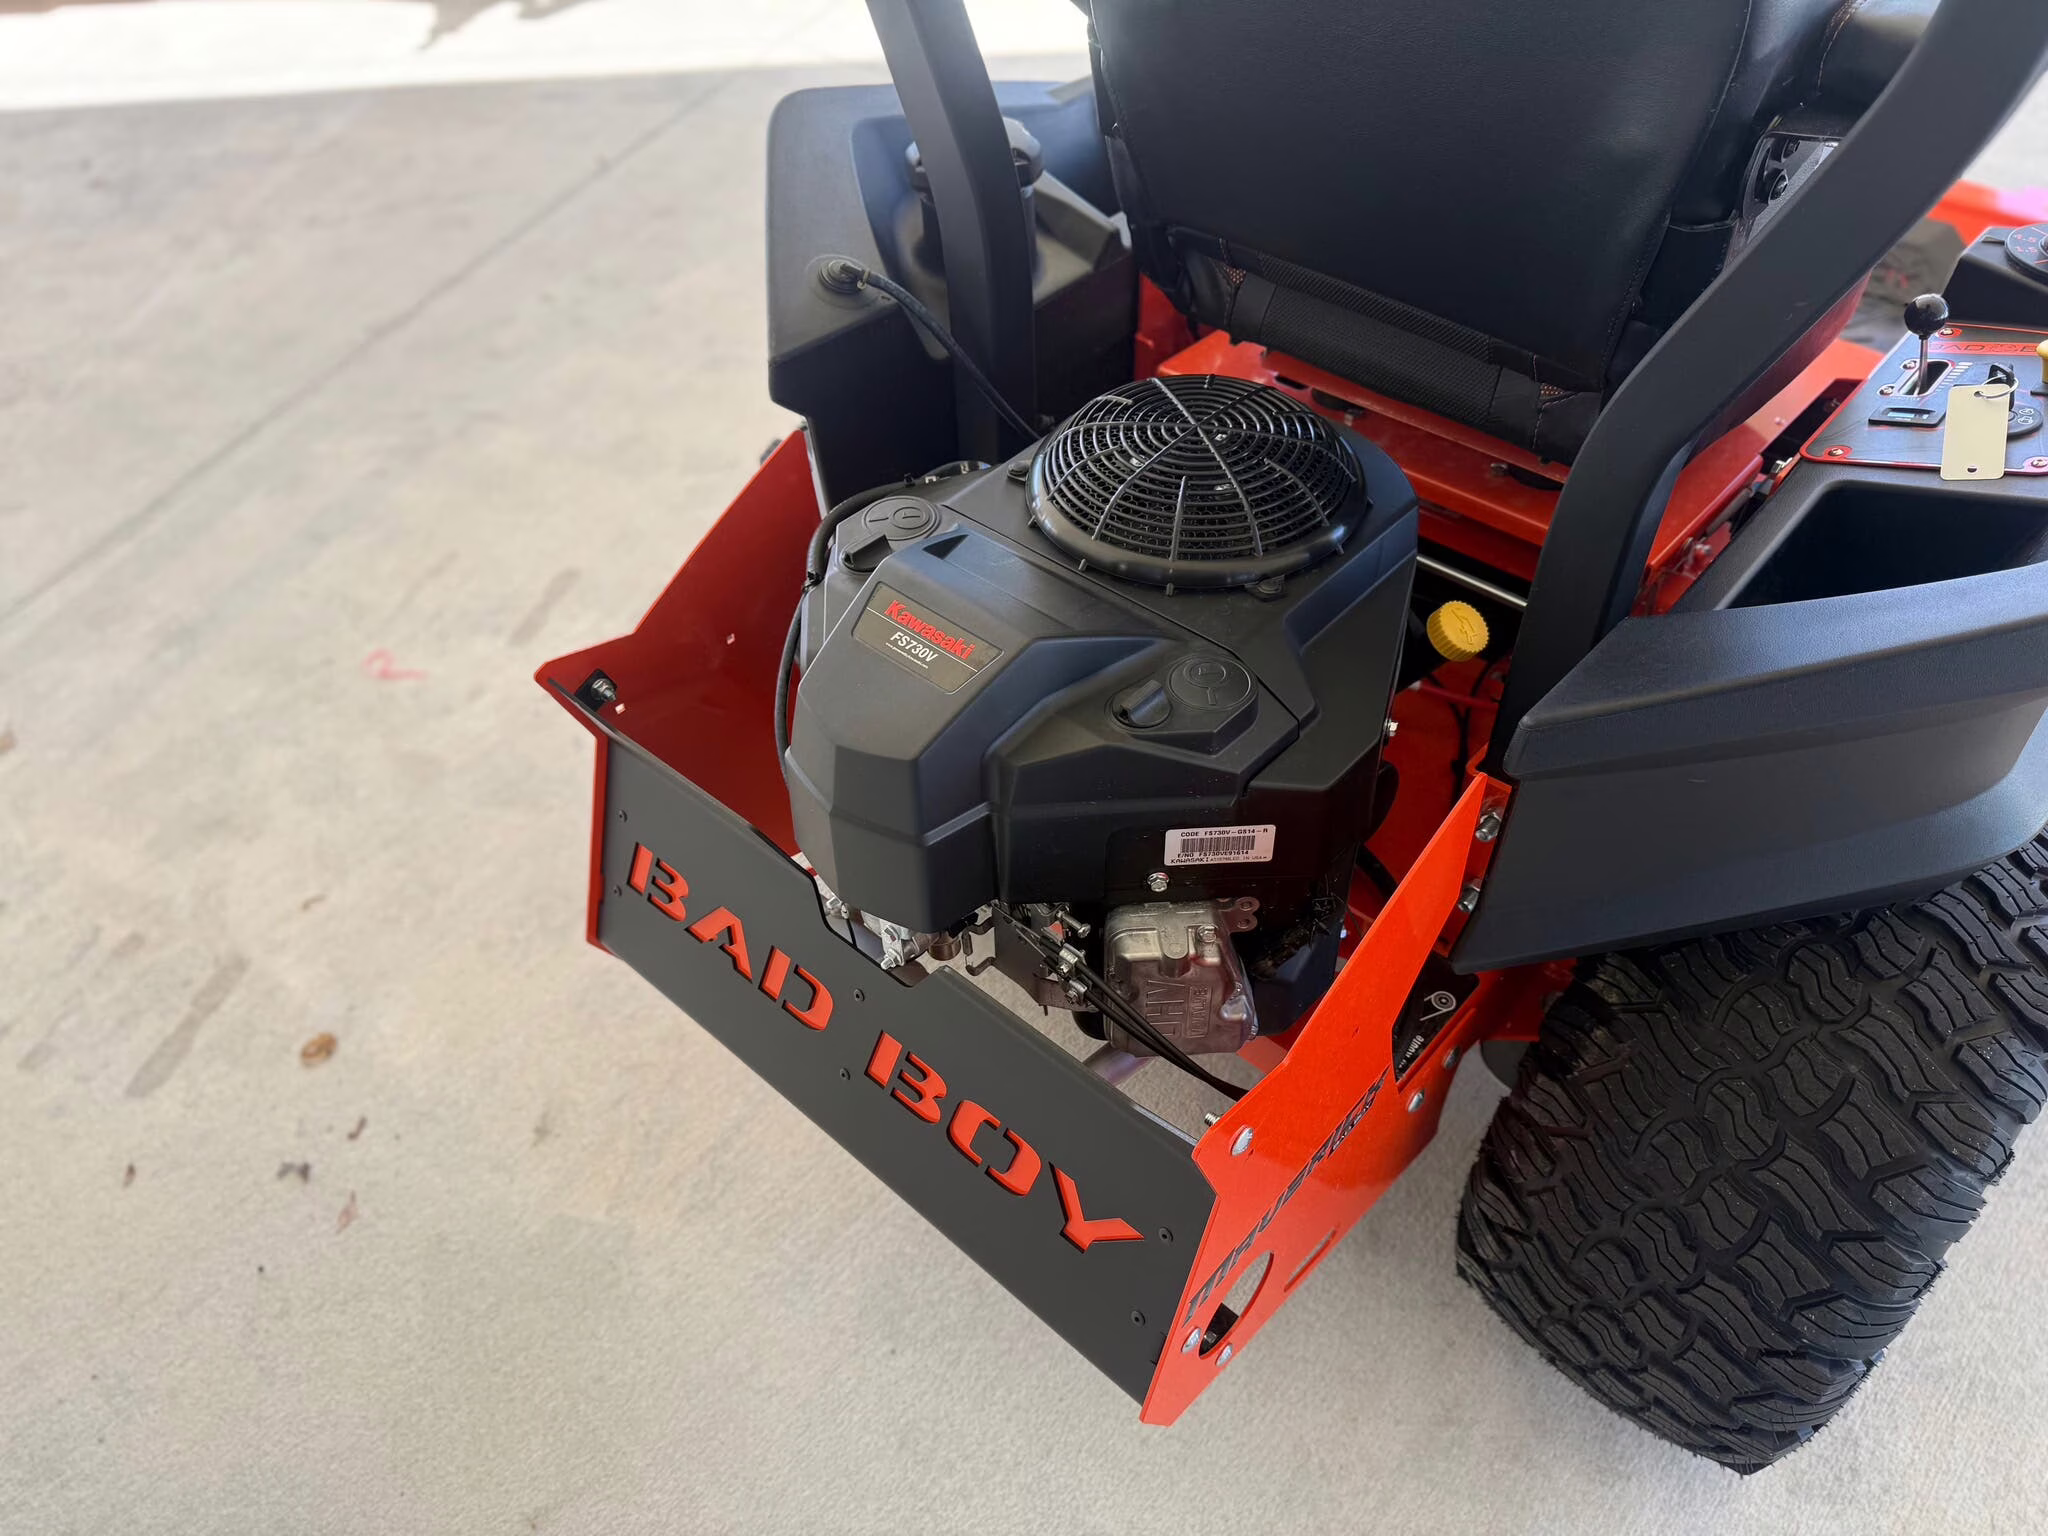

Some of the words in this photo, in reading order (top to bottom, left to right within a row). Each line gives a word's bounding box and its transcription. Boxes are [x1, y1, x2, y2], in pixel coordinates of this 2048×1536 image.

[884, 600, 976, 660] Kawasaki
[890, 631, 939, 662] FS730V
[627, 842, 835, 1032] BAD
[864, 1030, 1145, 1254] BOY
